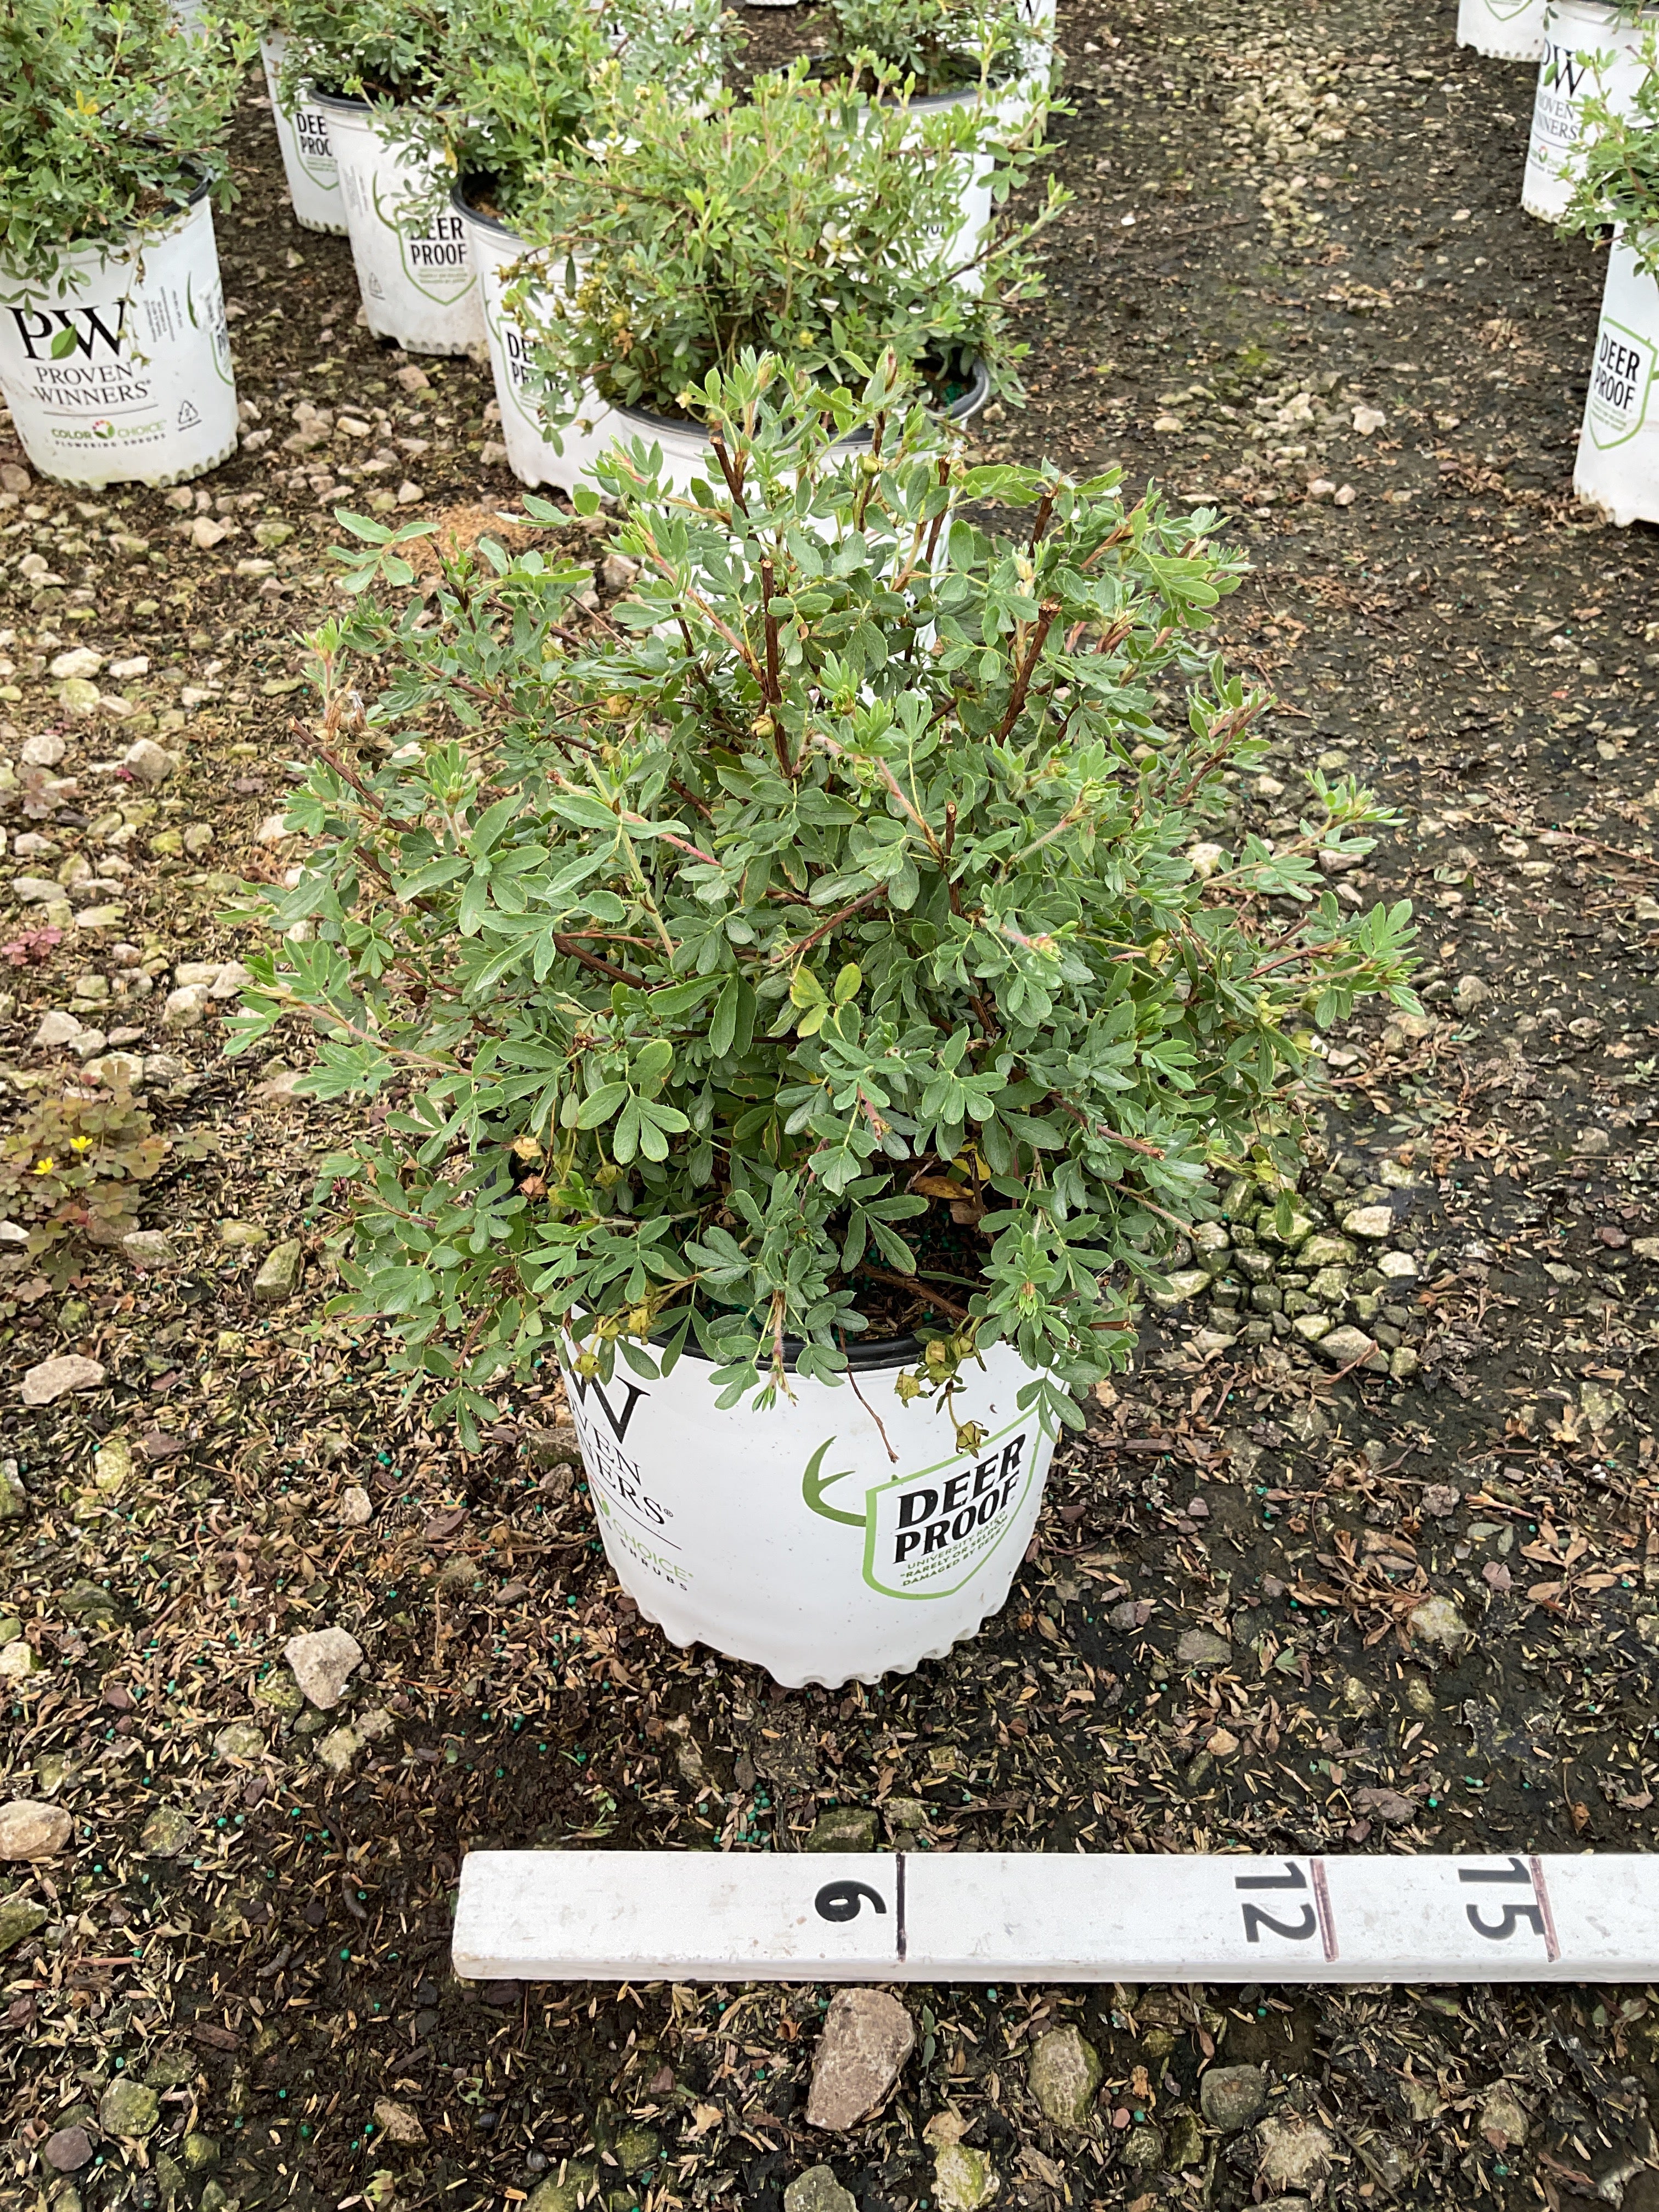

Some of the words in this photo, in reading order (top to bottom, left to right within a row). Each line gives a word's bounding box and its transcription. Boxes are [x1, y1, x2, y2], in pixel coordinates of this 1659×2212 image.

[296, 112, 328, 135] DEE
[411, 243, 467, 265] PROOF
[35, 362, 133, 385] PROVEN
[1599, 332, 1640, 383] DEER
[33, 381, 148, 405] WINNERS
[1594, 364, 1636, 410] PROOF
[52, 428, 92, 439] COLOR
[895, 1434, 1026, 1530] DEER
[893, 1469, 1019, 1564] PROOF
[908, 1534, 975, 1569] UNIVERSITY
[977, 1510, 1006, 1536] RATED
[952, 1546, 968, 1558] OR
[970, 1514, 1008, 1549] SELDOM
[613, 1519, 688, 1582] CHOICE
[620, 1538, 687, 1591] SHRUBS
[902, 1559, 960, 1587] DAMAGED
[963, 1548, 976, 1560] BY
[815, 1880, 887, 1922] 6
[1234, 1860, 1317, 1943] 12
[1458, 1857, 1546, 1941] 15
